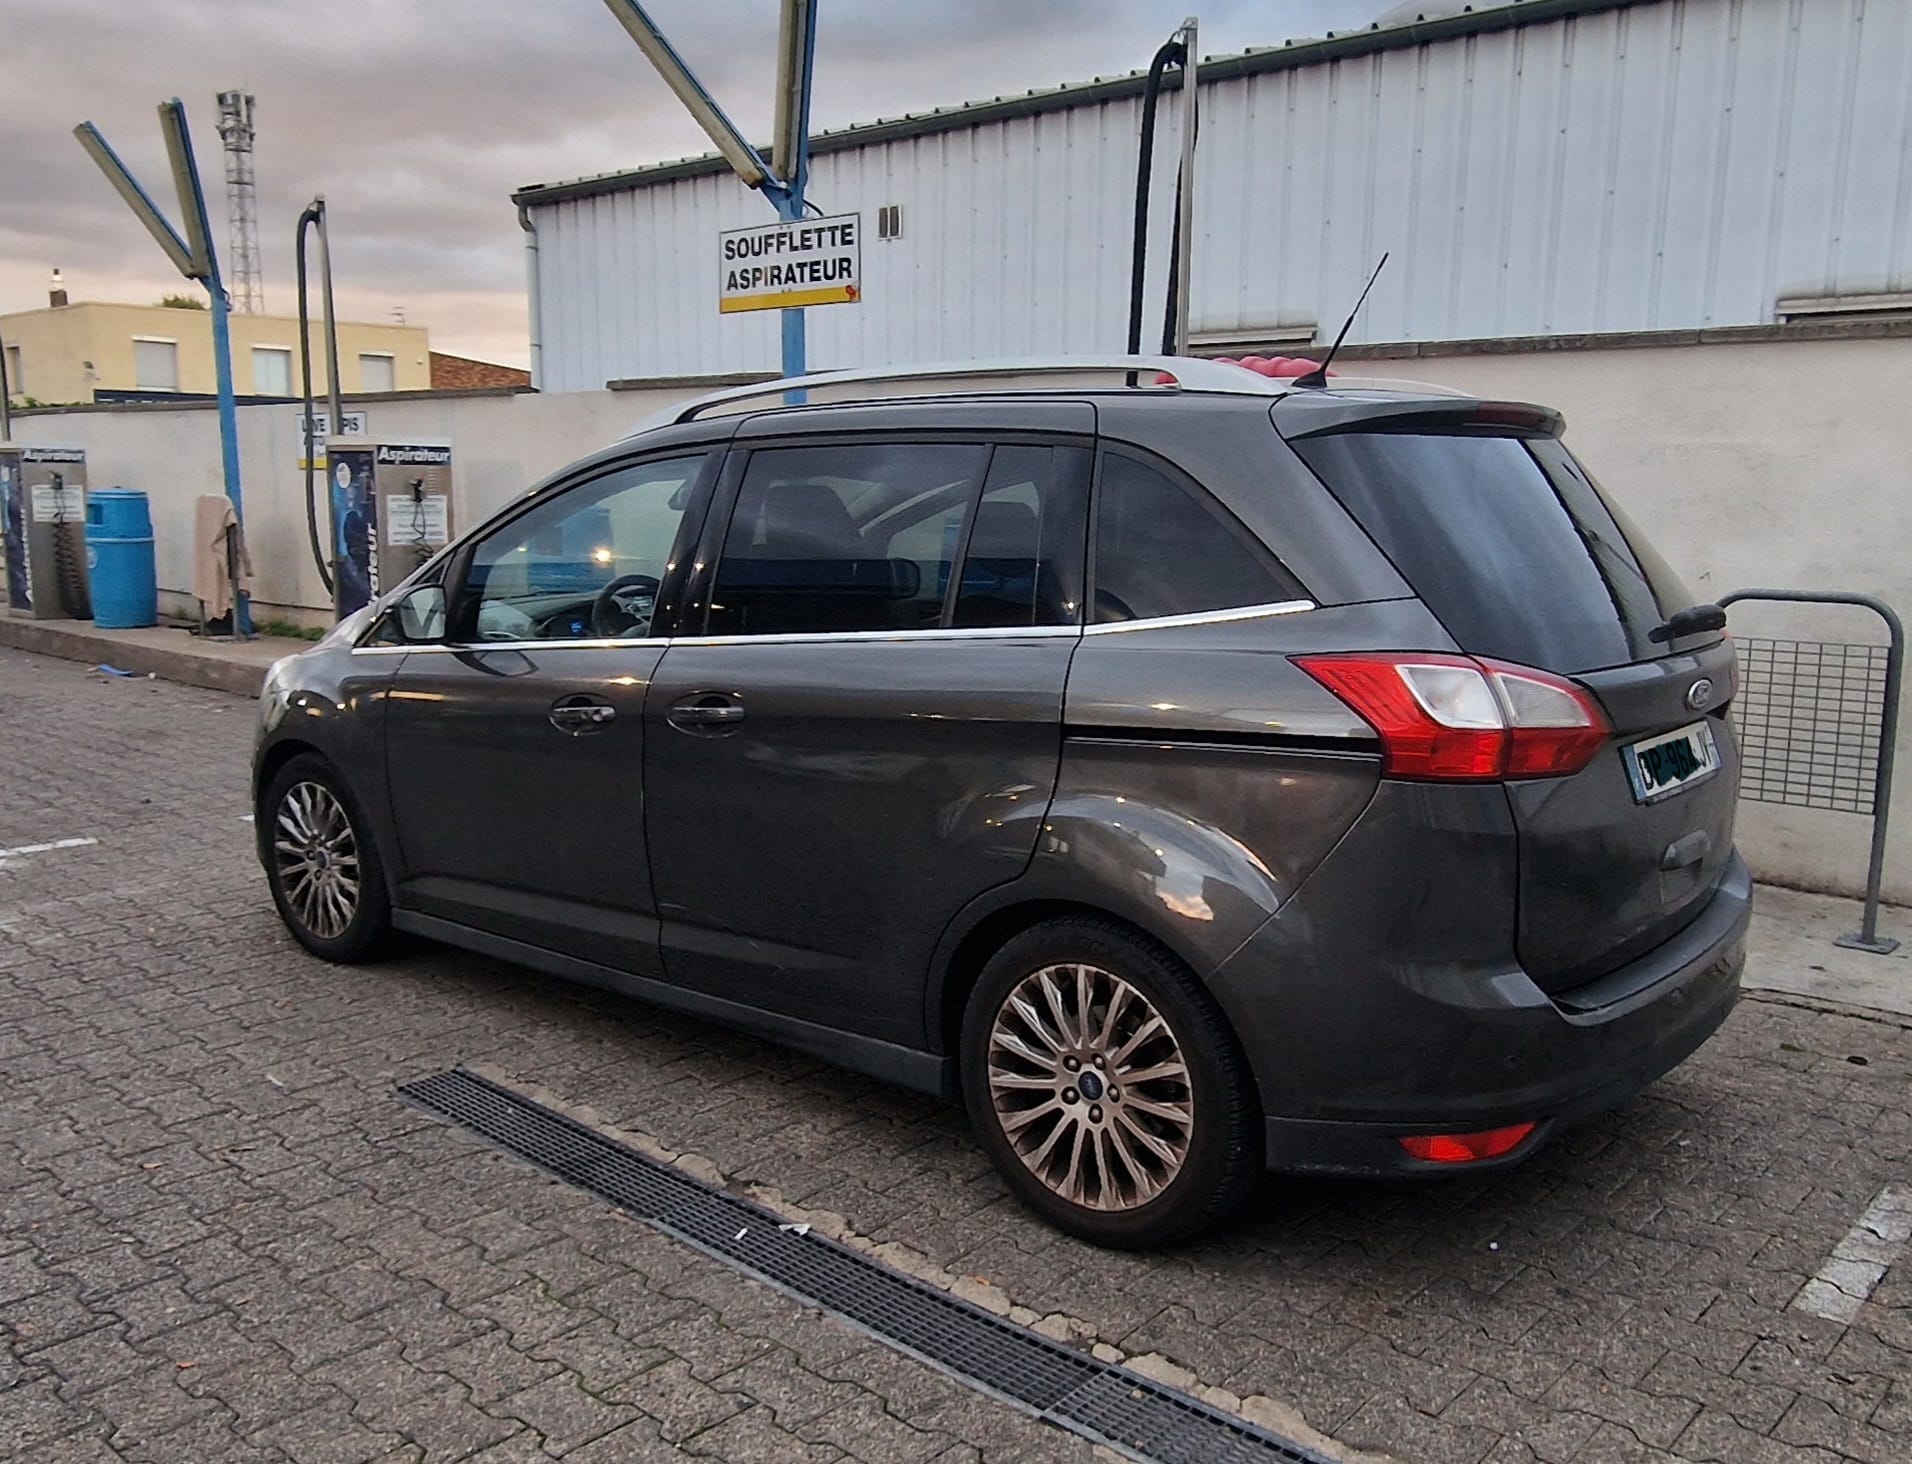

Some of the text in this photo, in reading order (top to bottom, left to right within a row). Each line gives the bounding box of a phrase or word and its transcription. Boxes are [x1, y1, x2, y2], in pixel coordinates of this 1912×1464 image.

[725, 224, 854, 260] SOUFFLETTE
[727, 257, 852, 291] ASPIRATEUR
[302, 418, 326, 432] LVE
[378, 446, 450, 464] Aspirateur
[367, 523, 380, 606] rateur
